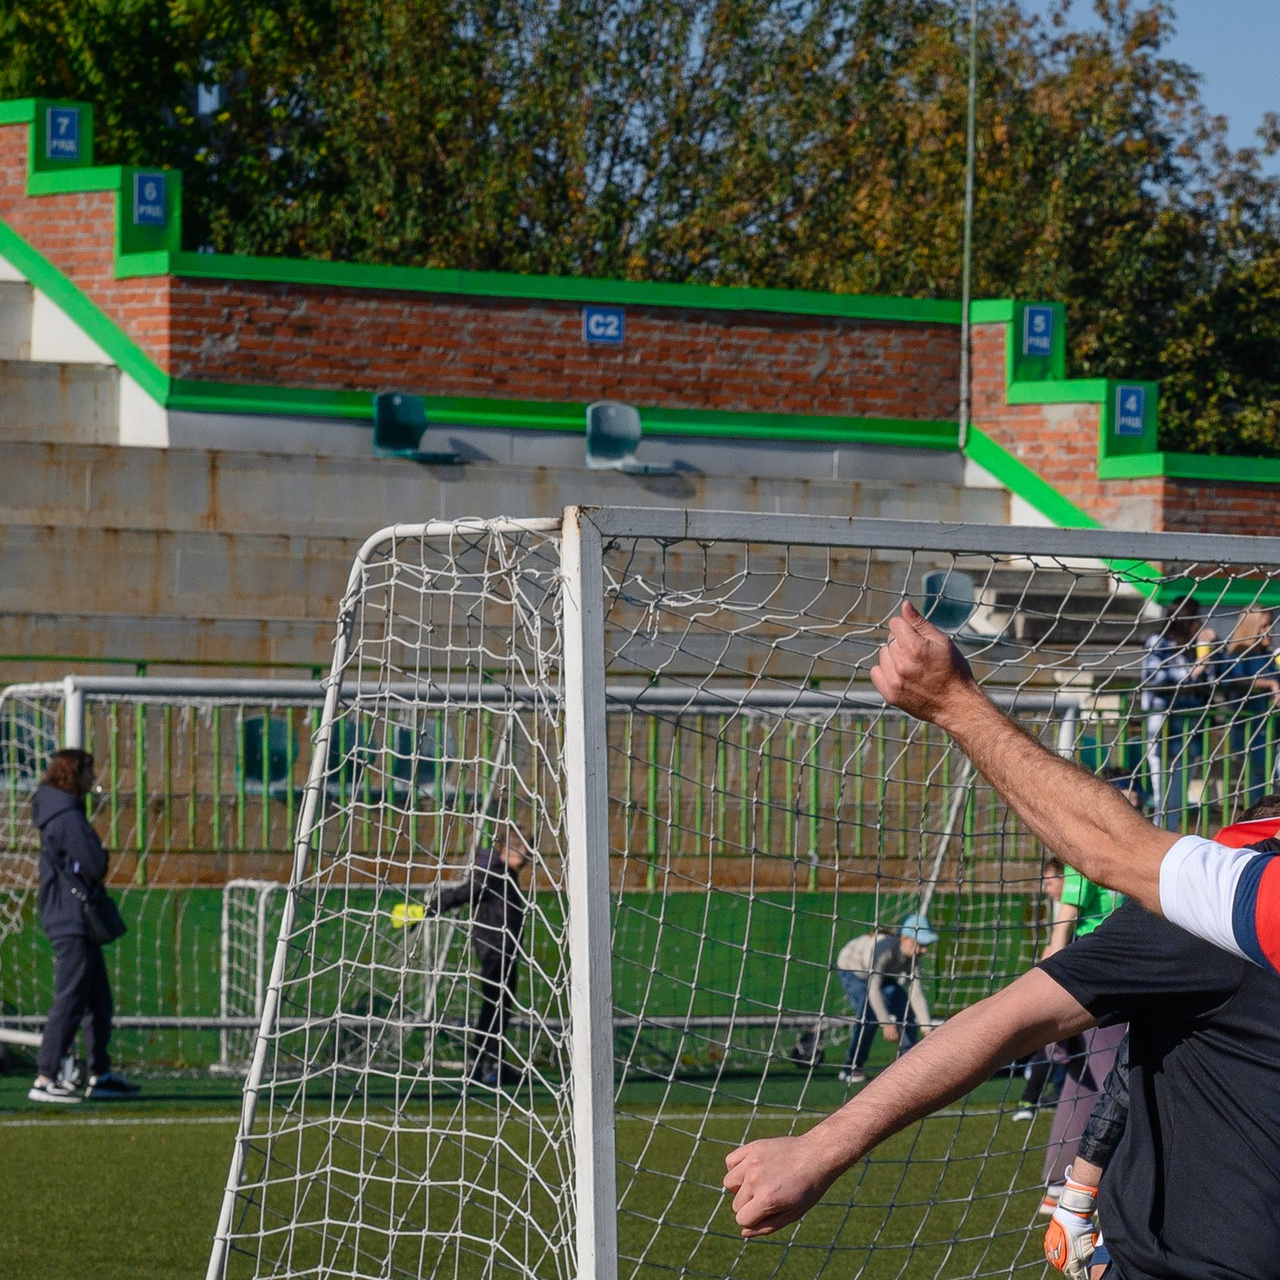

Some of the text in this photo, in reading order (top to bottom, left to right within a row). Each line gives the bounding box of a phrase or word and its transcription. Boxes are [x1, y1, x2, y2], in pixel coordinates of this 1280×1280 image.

[57, 116, 70, 135] 7
[144, 181, 157, 201] 6
[1124, 394, 1138, 413] 4
